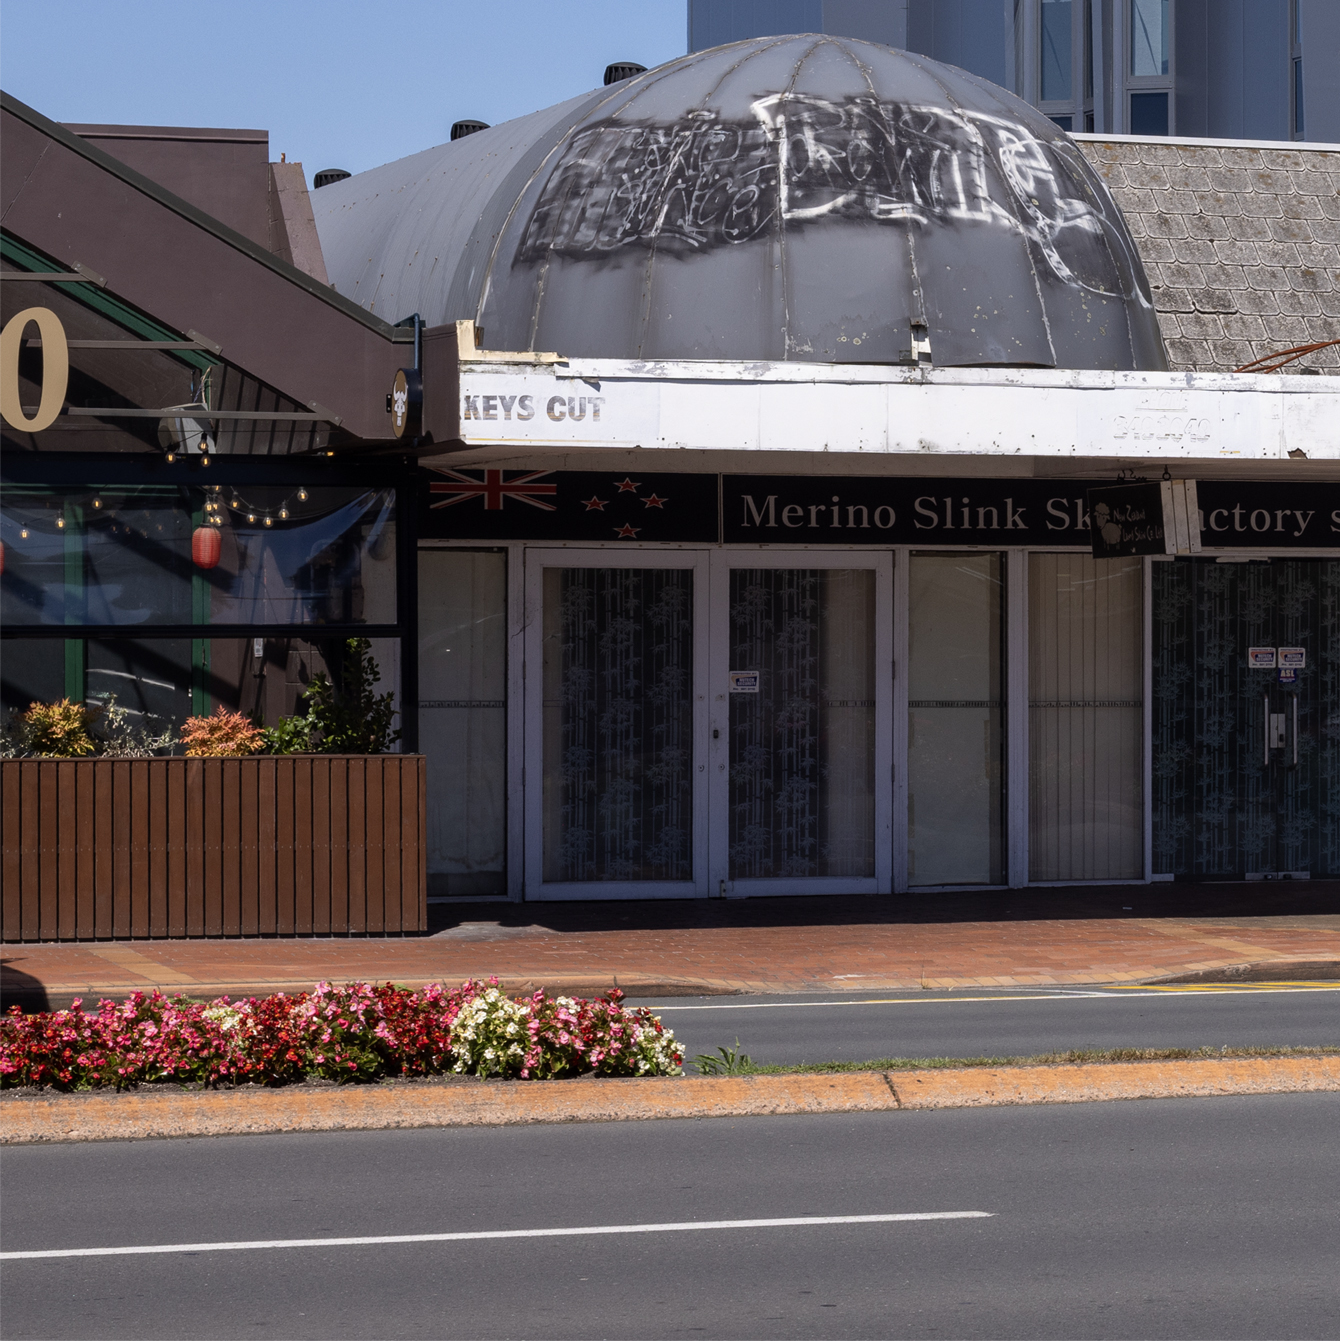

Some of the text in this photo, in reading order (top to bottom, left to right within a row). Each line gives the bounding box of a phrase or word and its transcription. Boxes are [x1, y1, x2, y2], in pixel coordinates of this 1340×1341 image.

[464, 395, 605, 422] KEYS CUT
[741, 495, 896, 529] Merino
[913, 496, 1029, 530] Slink
